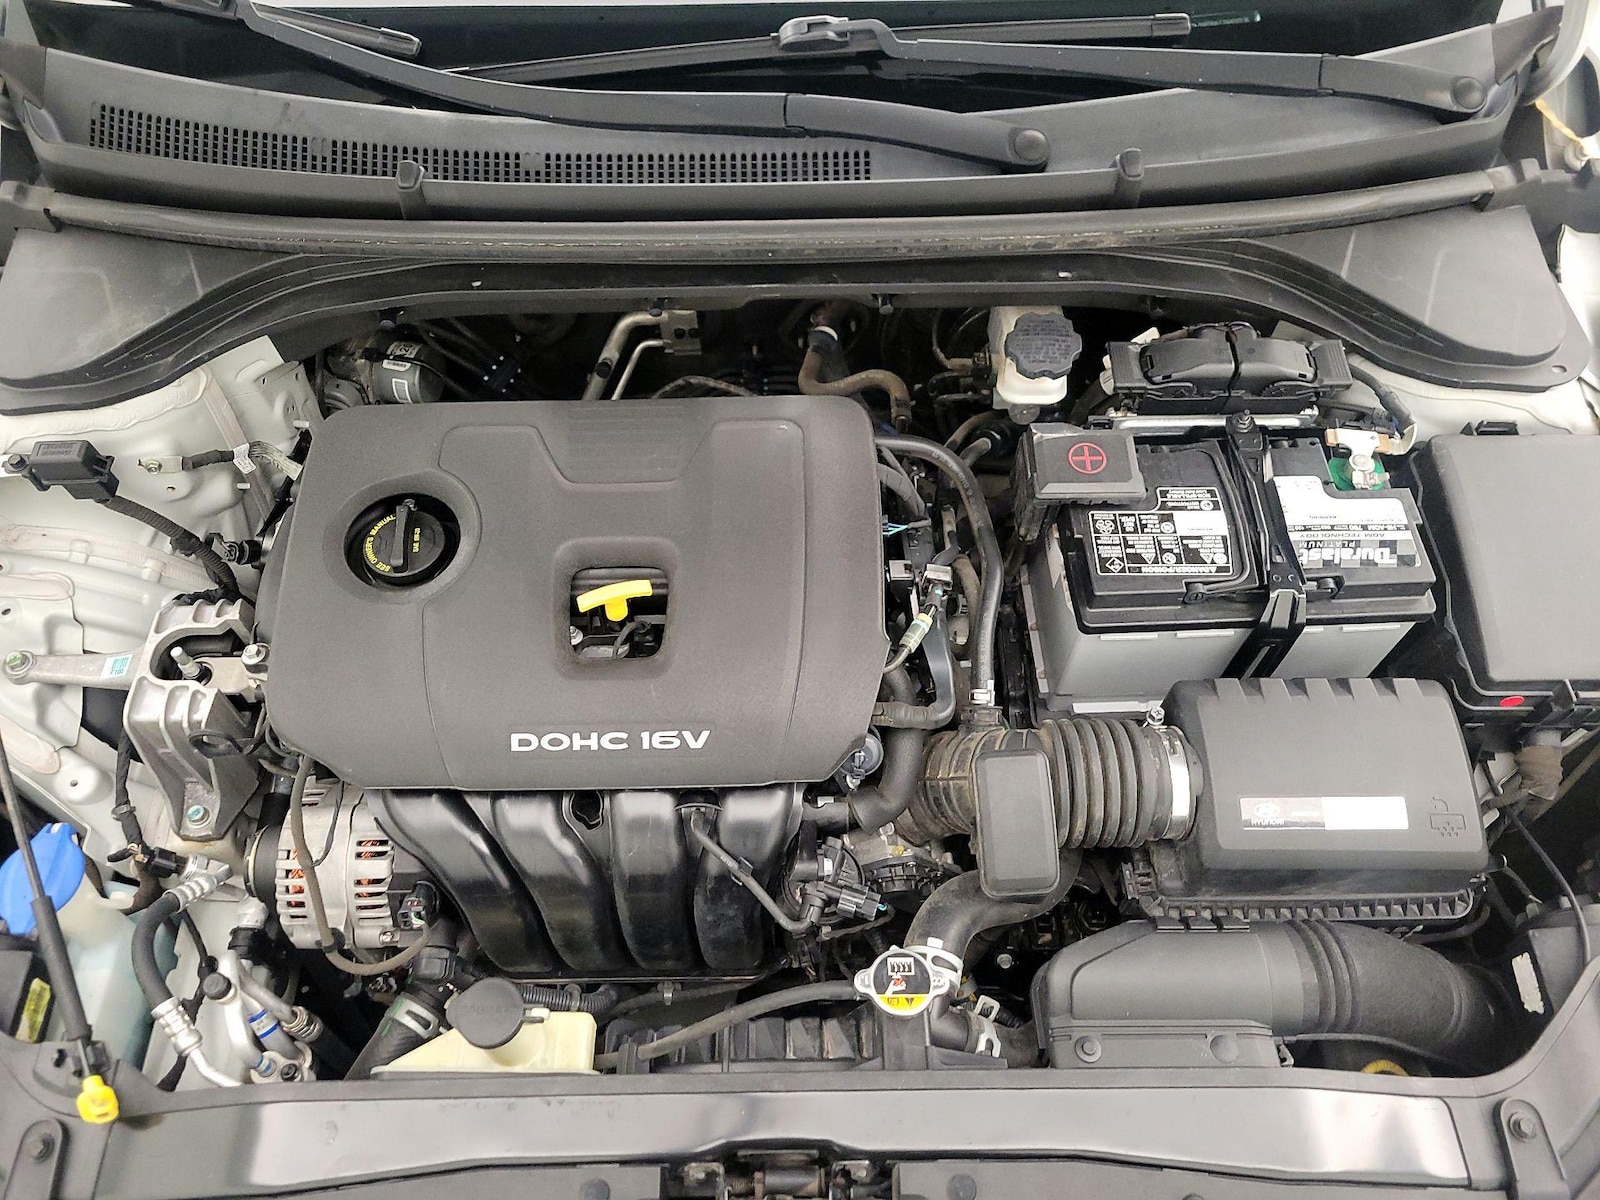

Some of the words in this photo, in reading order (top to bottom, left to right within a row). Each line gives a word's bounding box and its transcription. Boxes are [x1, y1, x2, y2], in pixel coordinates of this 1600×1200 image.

[370, 514, 396, 536] MANUAL
[1298, 540, 1356, 548] PLATINUM
[1298, 547, 1398, 565] Duralast
[376, 561, 391, 572] SEE
[510, 731, 629, 752] DOHC
[640, 730, 711, 750] 16V
[1251, 818, 1285, 826] HYUNDAI
